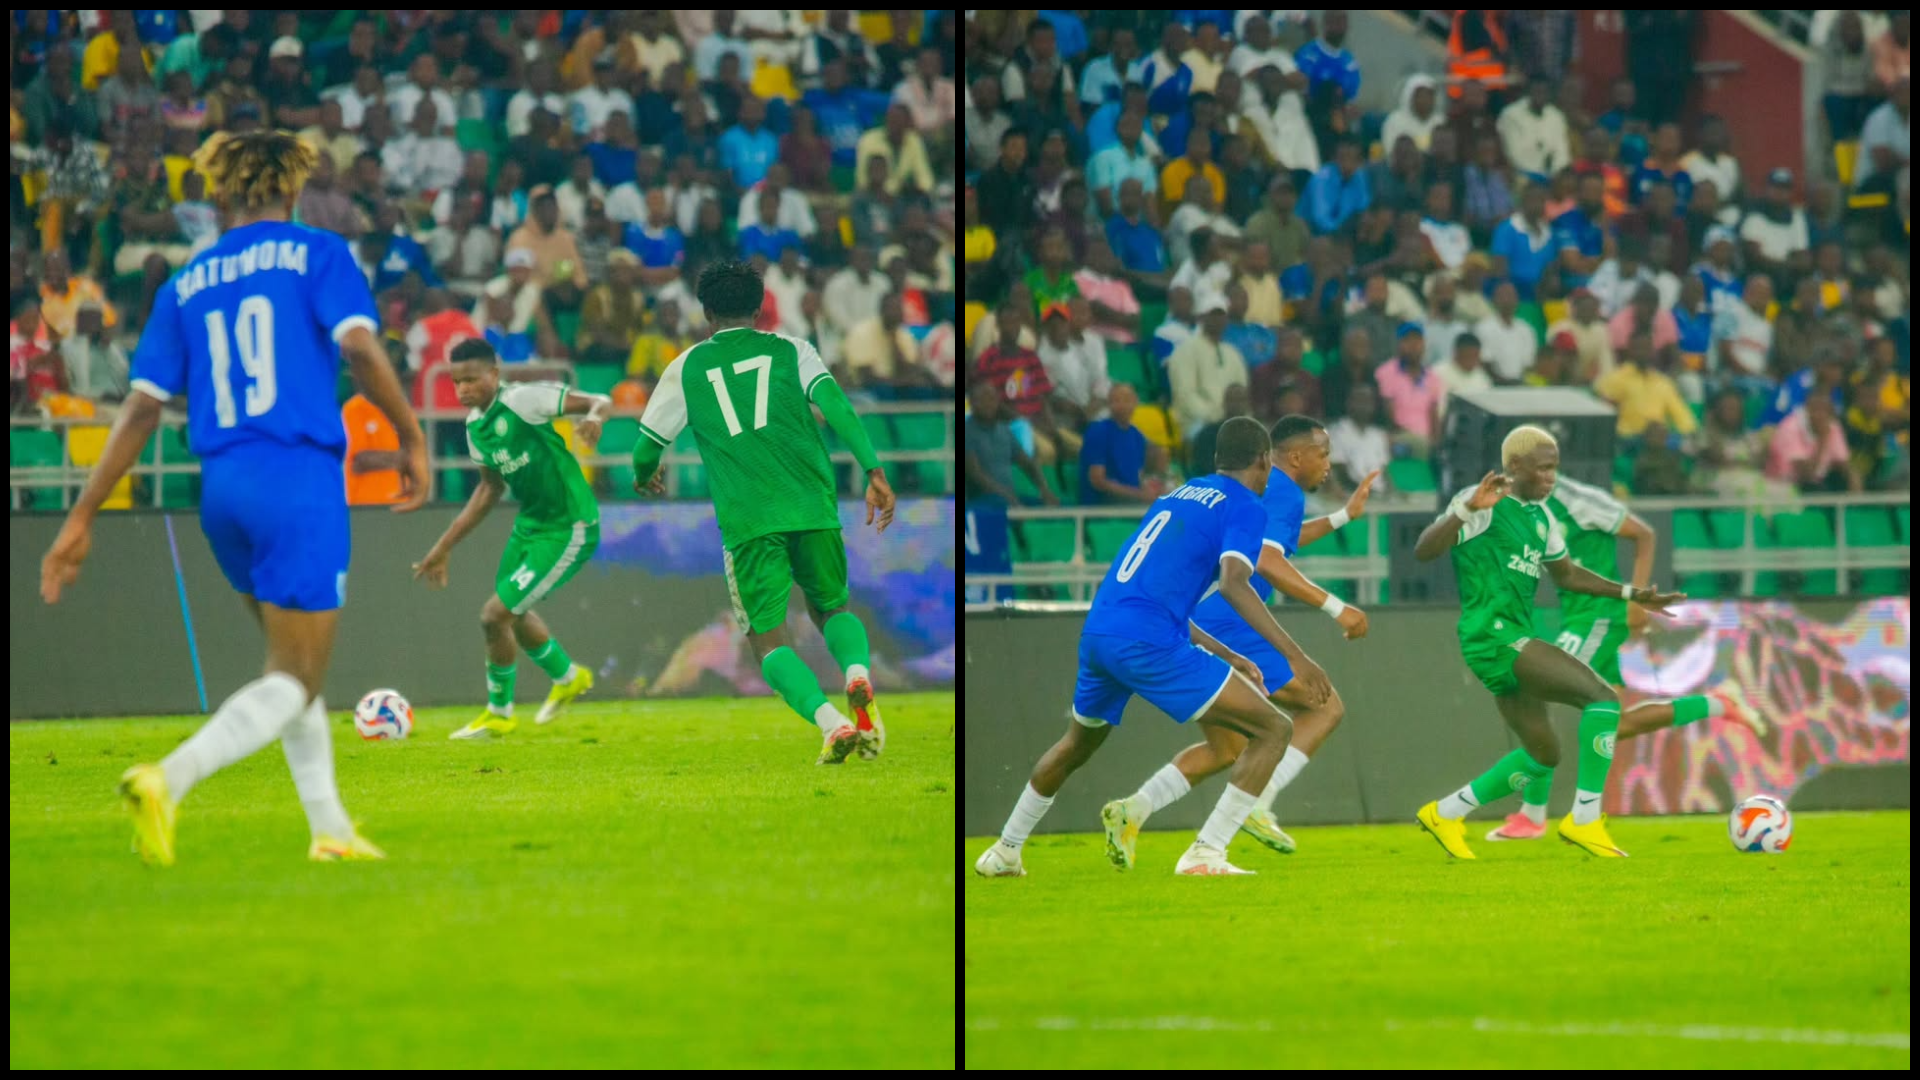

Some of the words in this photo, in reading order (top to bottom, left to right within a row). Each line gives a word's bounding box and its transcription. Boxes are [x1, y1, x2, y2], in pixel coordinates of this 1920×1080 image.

[205, 294, 278, 428] 19
[705, 355, 772, 437] 17
[510, 562, 536, 590] 14
[1116, 510, 1172, 583] 8
